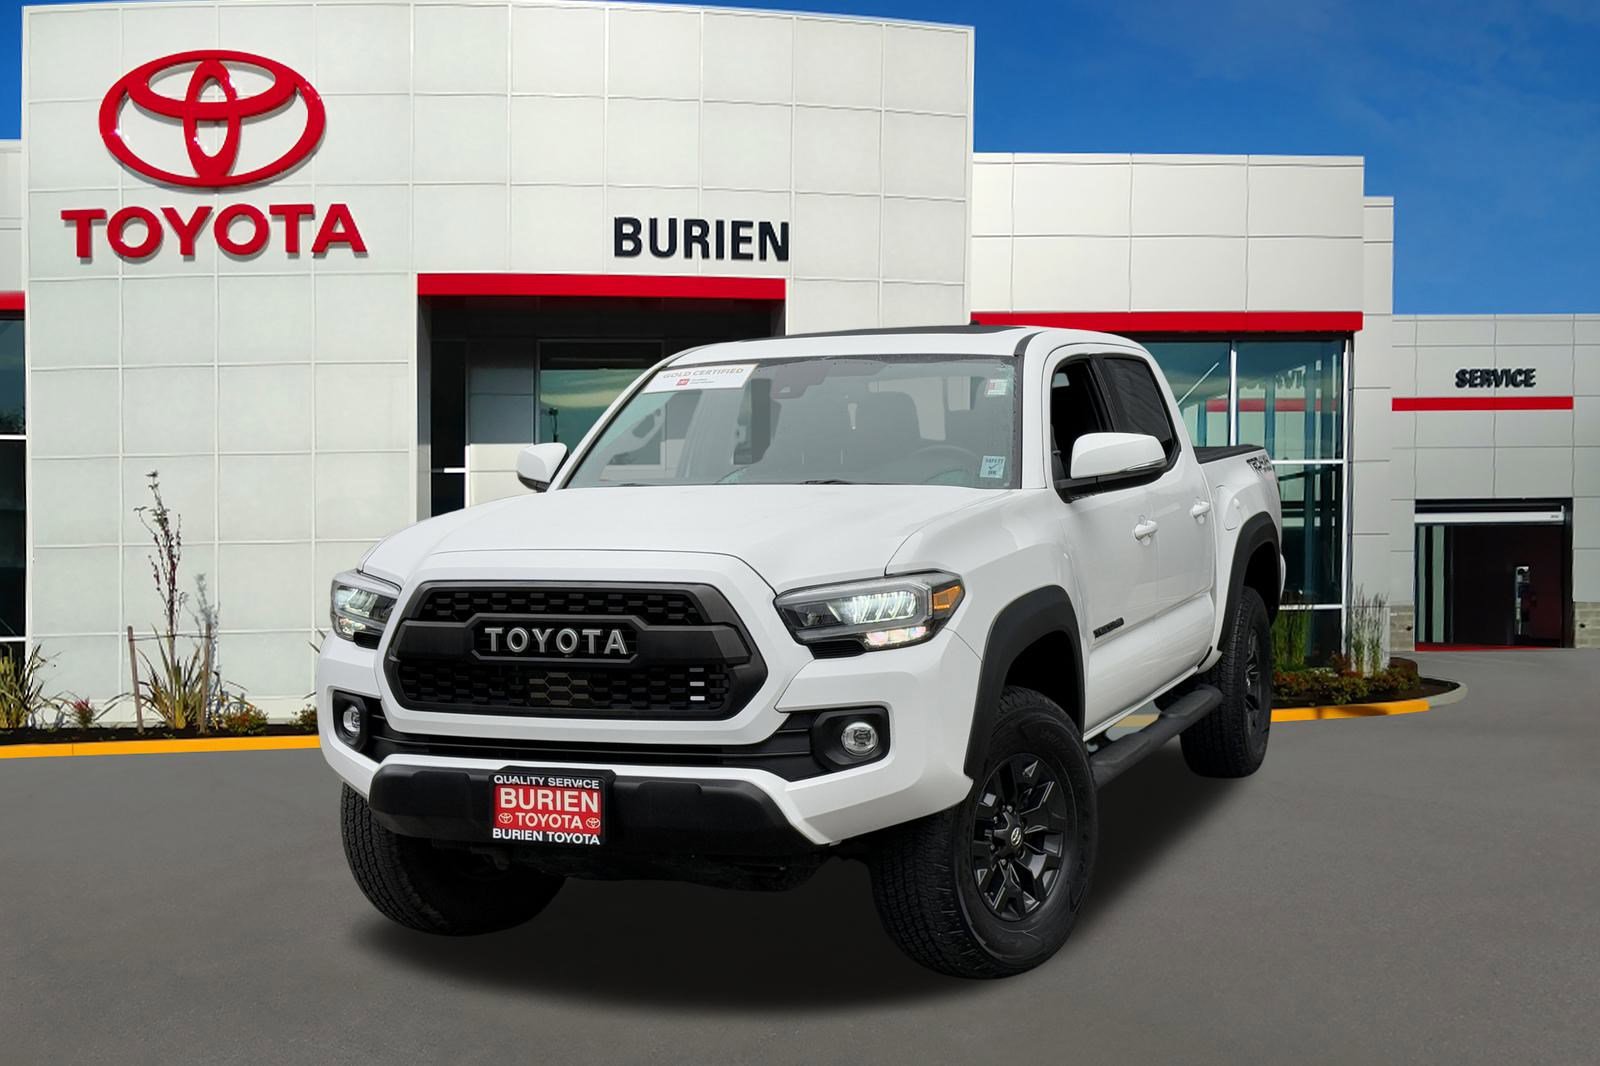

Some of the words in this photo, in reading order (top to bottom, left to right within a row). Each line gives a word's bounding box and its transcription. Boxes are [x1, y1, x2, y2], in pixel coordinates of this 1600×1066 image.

[61, 203, 369, 259] TOYOTA
[614, 216, 790, 261] BURIEN
[692, 367, 744, 376] CERTIFIED
[1455, 368, 1537, 389] SERVICE
[484, 627, 629, 655] TOYOTA
[493, 775, 545, 786] QUALITY
[547, 776, 600, 789] SERVICE
[500, 787, 599, 813] BURIEN
[515, 812, 584, 830] TOYOTA
[492, 828, 543, 842] BURIEN
[546, 831, 600, 845] TOYOTA
